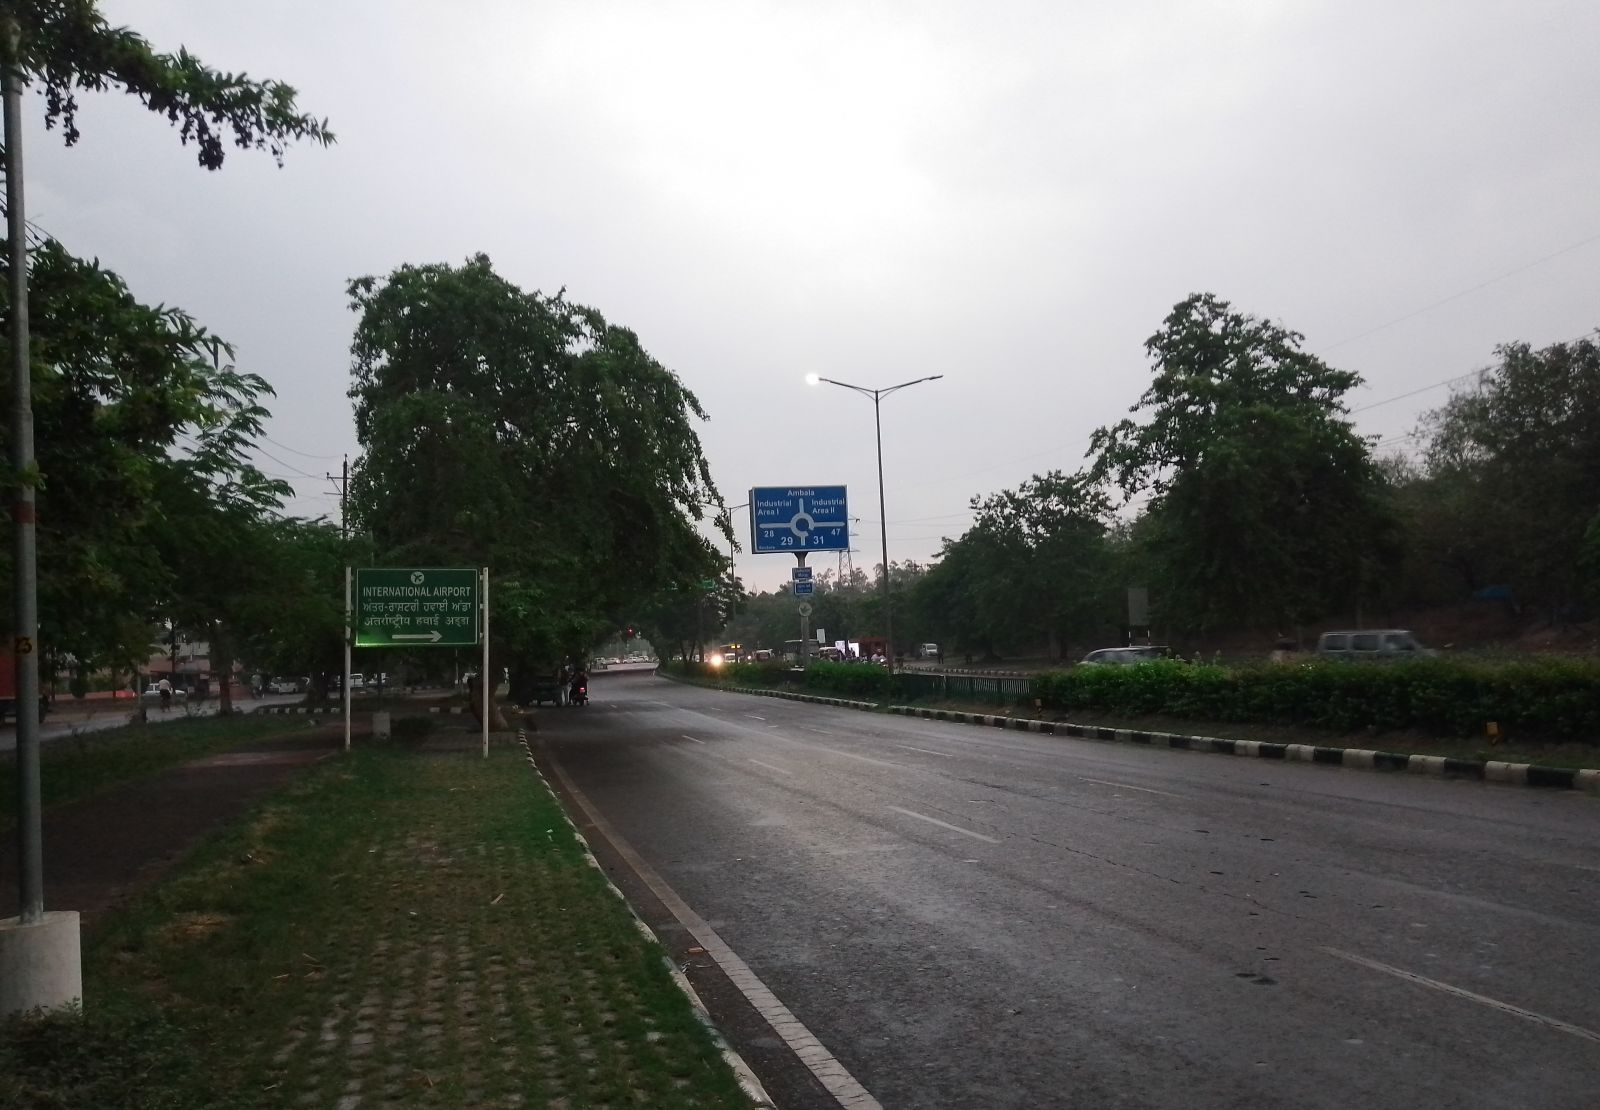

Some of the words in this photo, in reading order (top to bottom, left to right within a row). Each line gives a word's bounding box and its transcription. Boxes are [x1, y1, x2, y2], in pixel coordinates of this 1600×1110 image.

[757, 500, 792, 508] Industrial
[812, 498, 845, 506] Industrial
[831, 528, 841, 536] 47
[781, 536, 793, 545] 29
[813, 535, 824, 544] 31
[363, 586, 431, 597] INTERNATIONAL
[433, 586, 471, 597] AIRPORT
